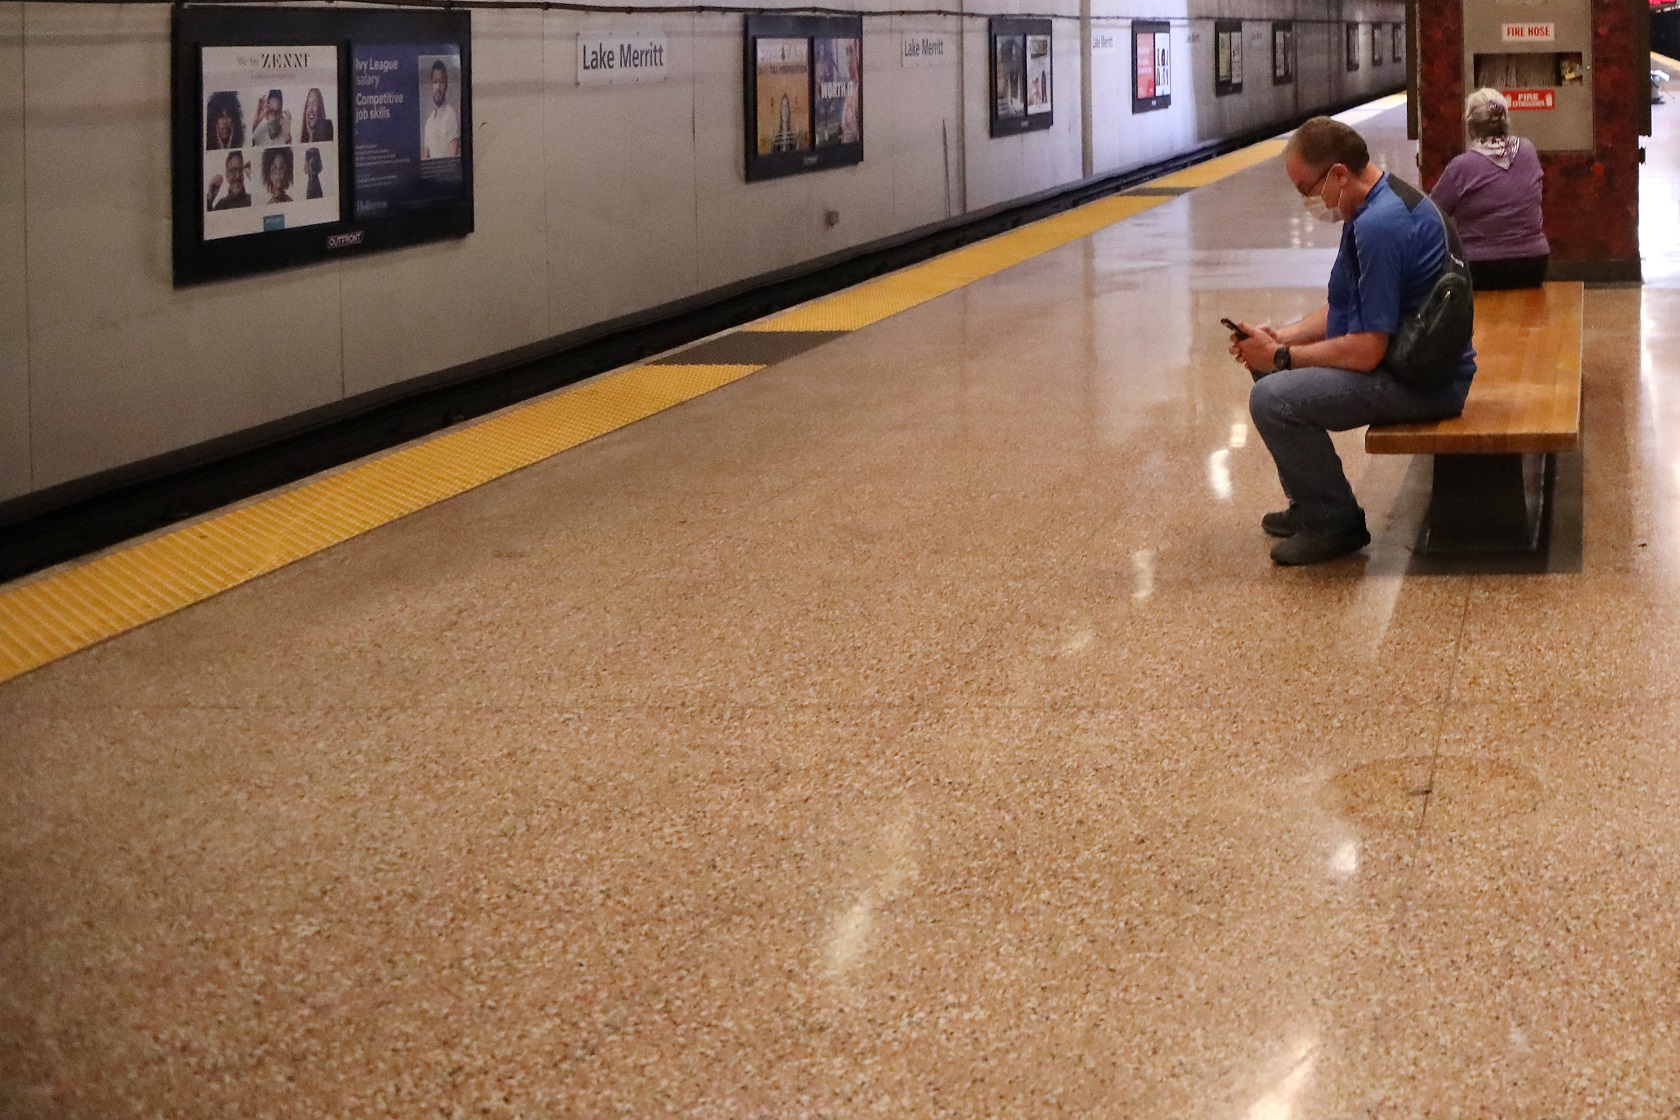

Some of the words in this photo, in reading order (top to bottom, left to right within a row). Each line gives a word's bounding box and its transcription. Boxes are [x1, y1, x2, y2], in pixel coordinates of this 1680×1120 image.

[1507, 27, 1525, 37] FIRE
[1528, 26, 1550, 37] HOSE
[905, 38, 920, 56] Lake
[922, 38, 944, 55] Merritt
[261, 53, 308, 68] ZENNI
[583, 42, 615, 70] Lake
[620, 42, 664, 68] Merritt
[369, 58, 398, 73] League
[356, 72, 380, 88] salary
[356, 92, 404, 108] Competitive
[370, 106, 391, 120] skills
[329, 233, 362, 247] OUTFRONT
